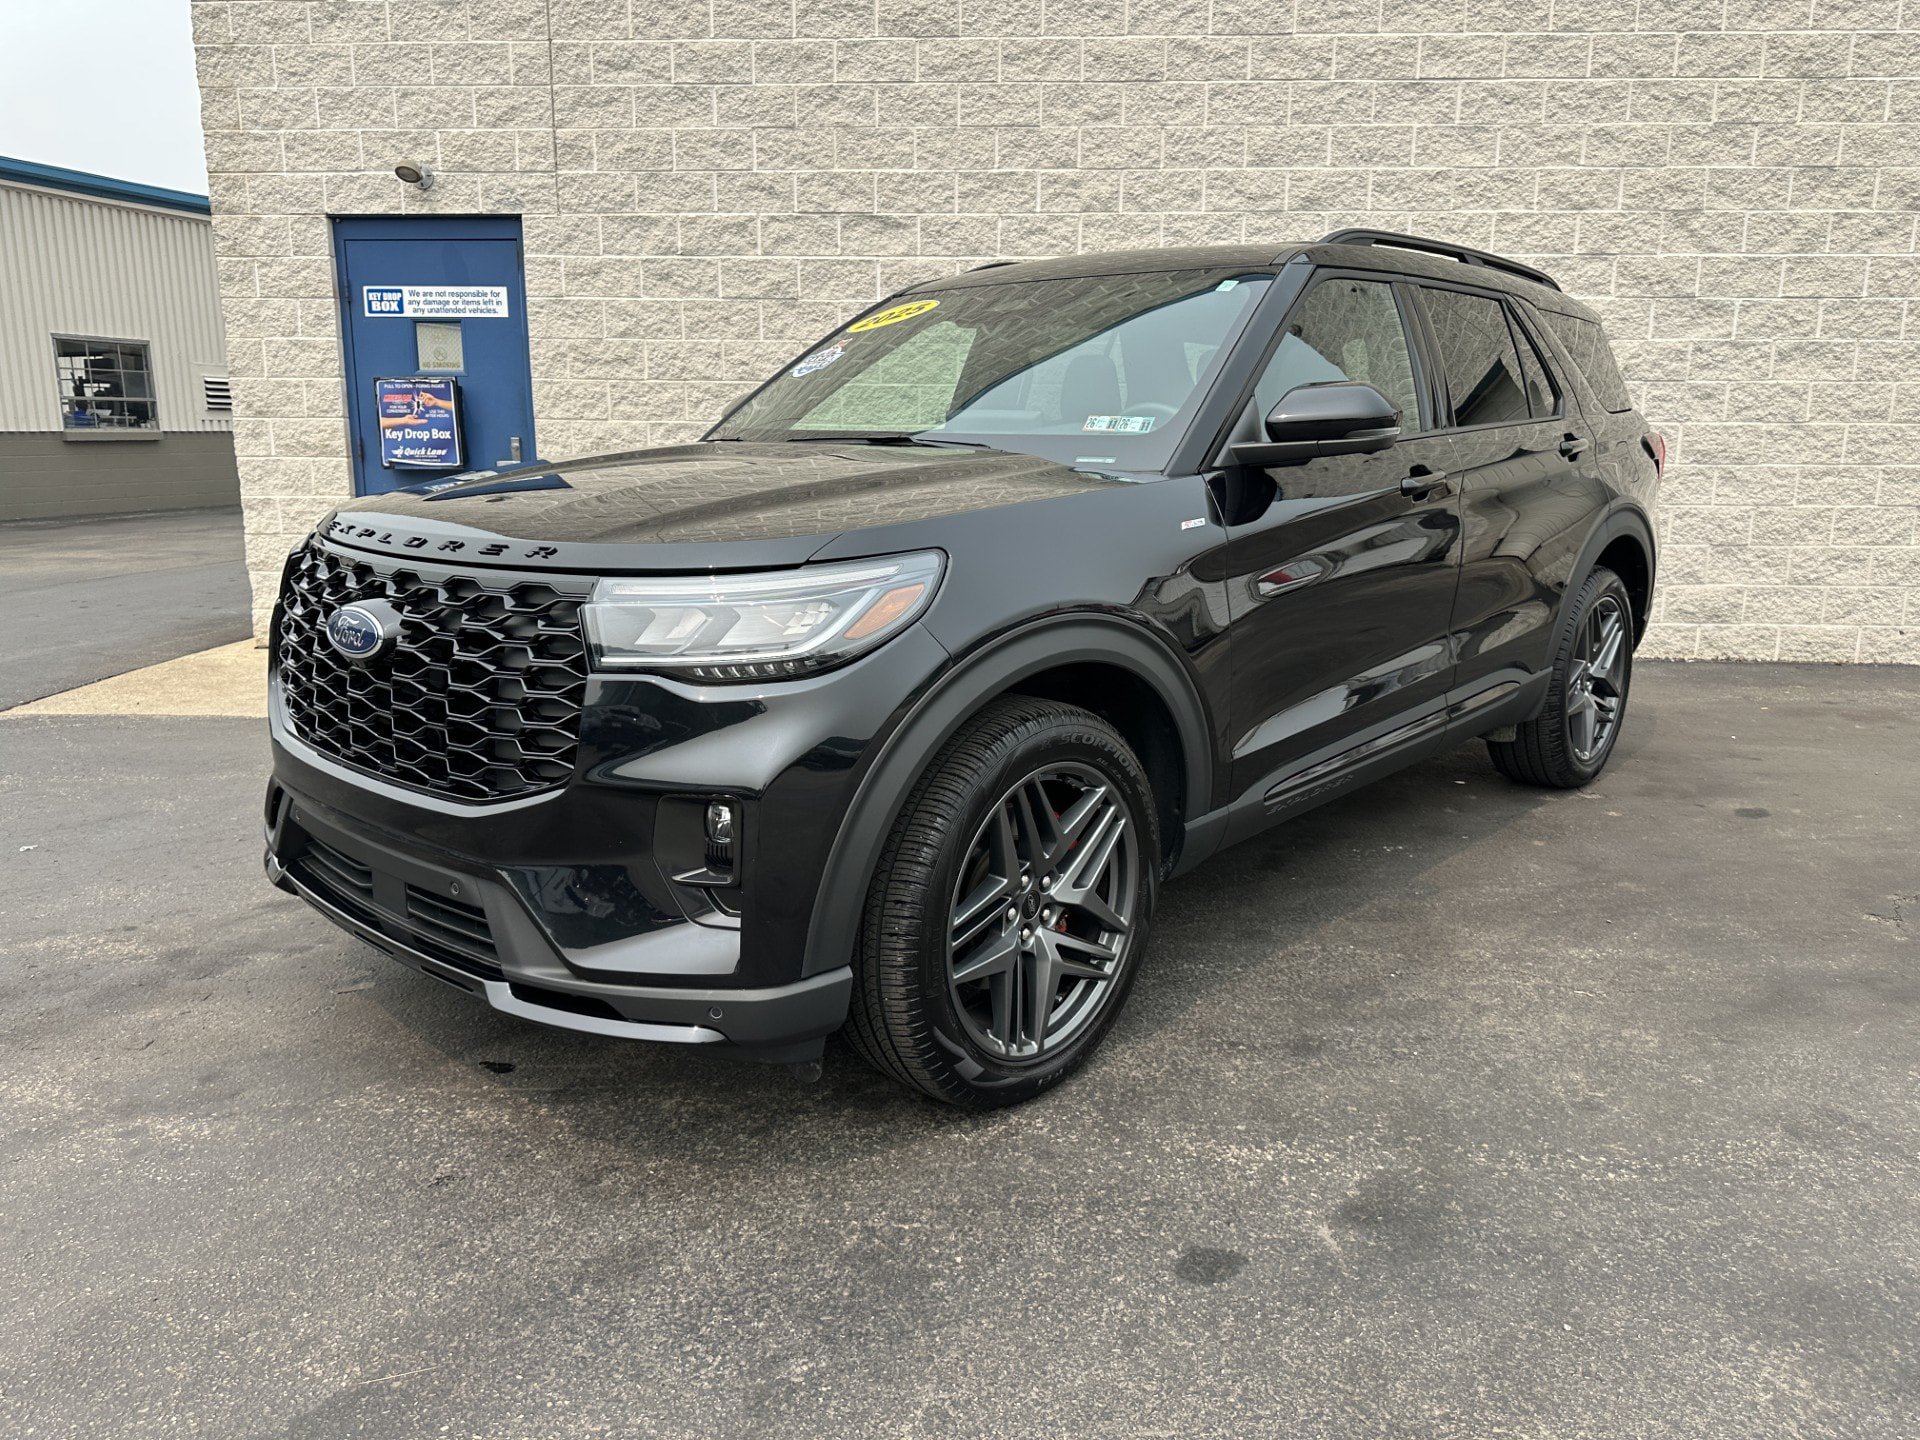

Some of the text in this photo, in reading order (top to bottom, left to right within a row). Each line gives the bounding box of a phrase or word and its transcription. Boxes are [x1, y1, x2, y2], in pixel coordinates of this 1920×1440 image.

[368, 292, 402, 300] KEY DROP
[408, 289, 420, 297] We
[447, 289, 489, 299] responsible
[490, 289, 501, 298] for
[371, 300, 400, 312] BOX
[408, 299, 421, 307] any
[422, 298, 450, 307] damage
[412, 305, 499, 315] any unattended vehicles.
[855, 302, 931, 329] 2025
[1106, 419, 1118, 430] 11
[1139, 421, 1151, 431] 11
[385, 428, 451, 442] Key Drop Box
[404, 447, 448, 456] Quick Lane
[327, 519, 559, 560] EXPLORER
[332, 615, 366, 647] Ford
[1060, 731, 1138, 778] SCORPION
